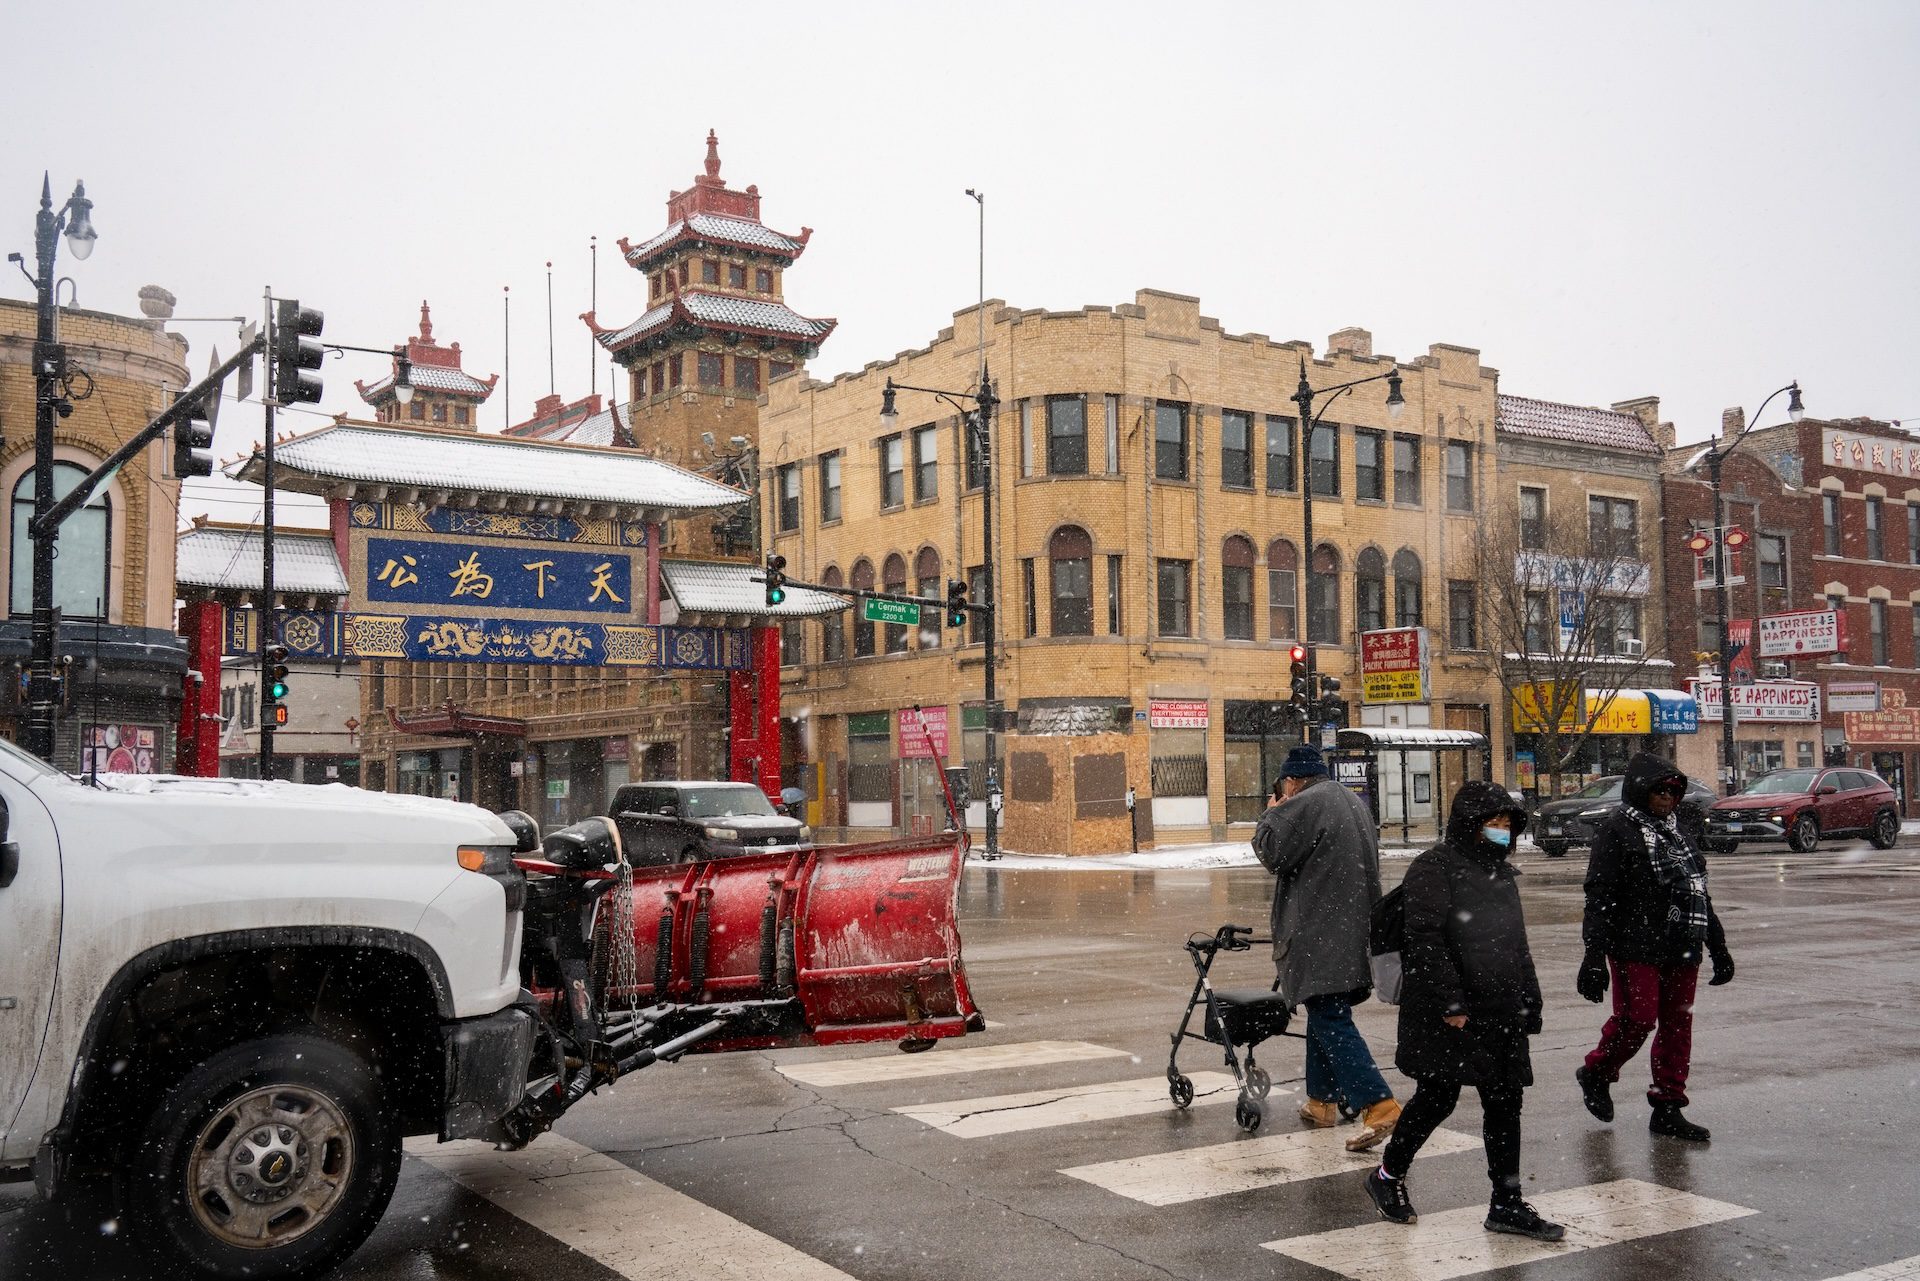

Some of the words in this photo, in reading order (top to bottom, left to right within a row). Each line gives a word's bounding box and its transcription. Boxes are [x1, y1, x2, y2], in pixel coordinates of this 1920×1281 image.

[877, 601, 907, 613] Cermak
[910, 607, 917, 615] Rd
[882, 612, 898, 621] 2200
[1778, 617, 1817, 629] THREE
[1764, 626, 1833, 641] HAPPINESS
[1367, 633, 1414, 649] 太平洋
[1365, 660, 1383, 670] PACIFIC
[1384, 659, 1410, 669] FURNITURE
[1746, 688, 1809, 705] HAPPINESS
[1860, 711, 1873, 722] Yee
[900, 723, 917, 732] PACIFIC
[909, 855, 951, 871] WESTERN
